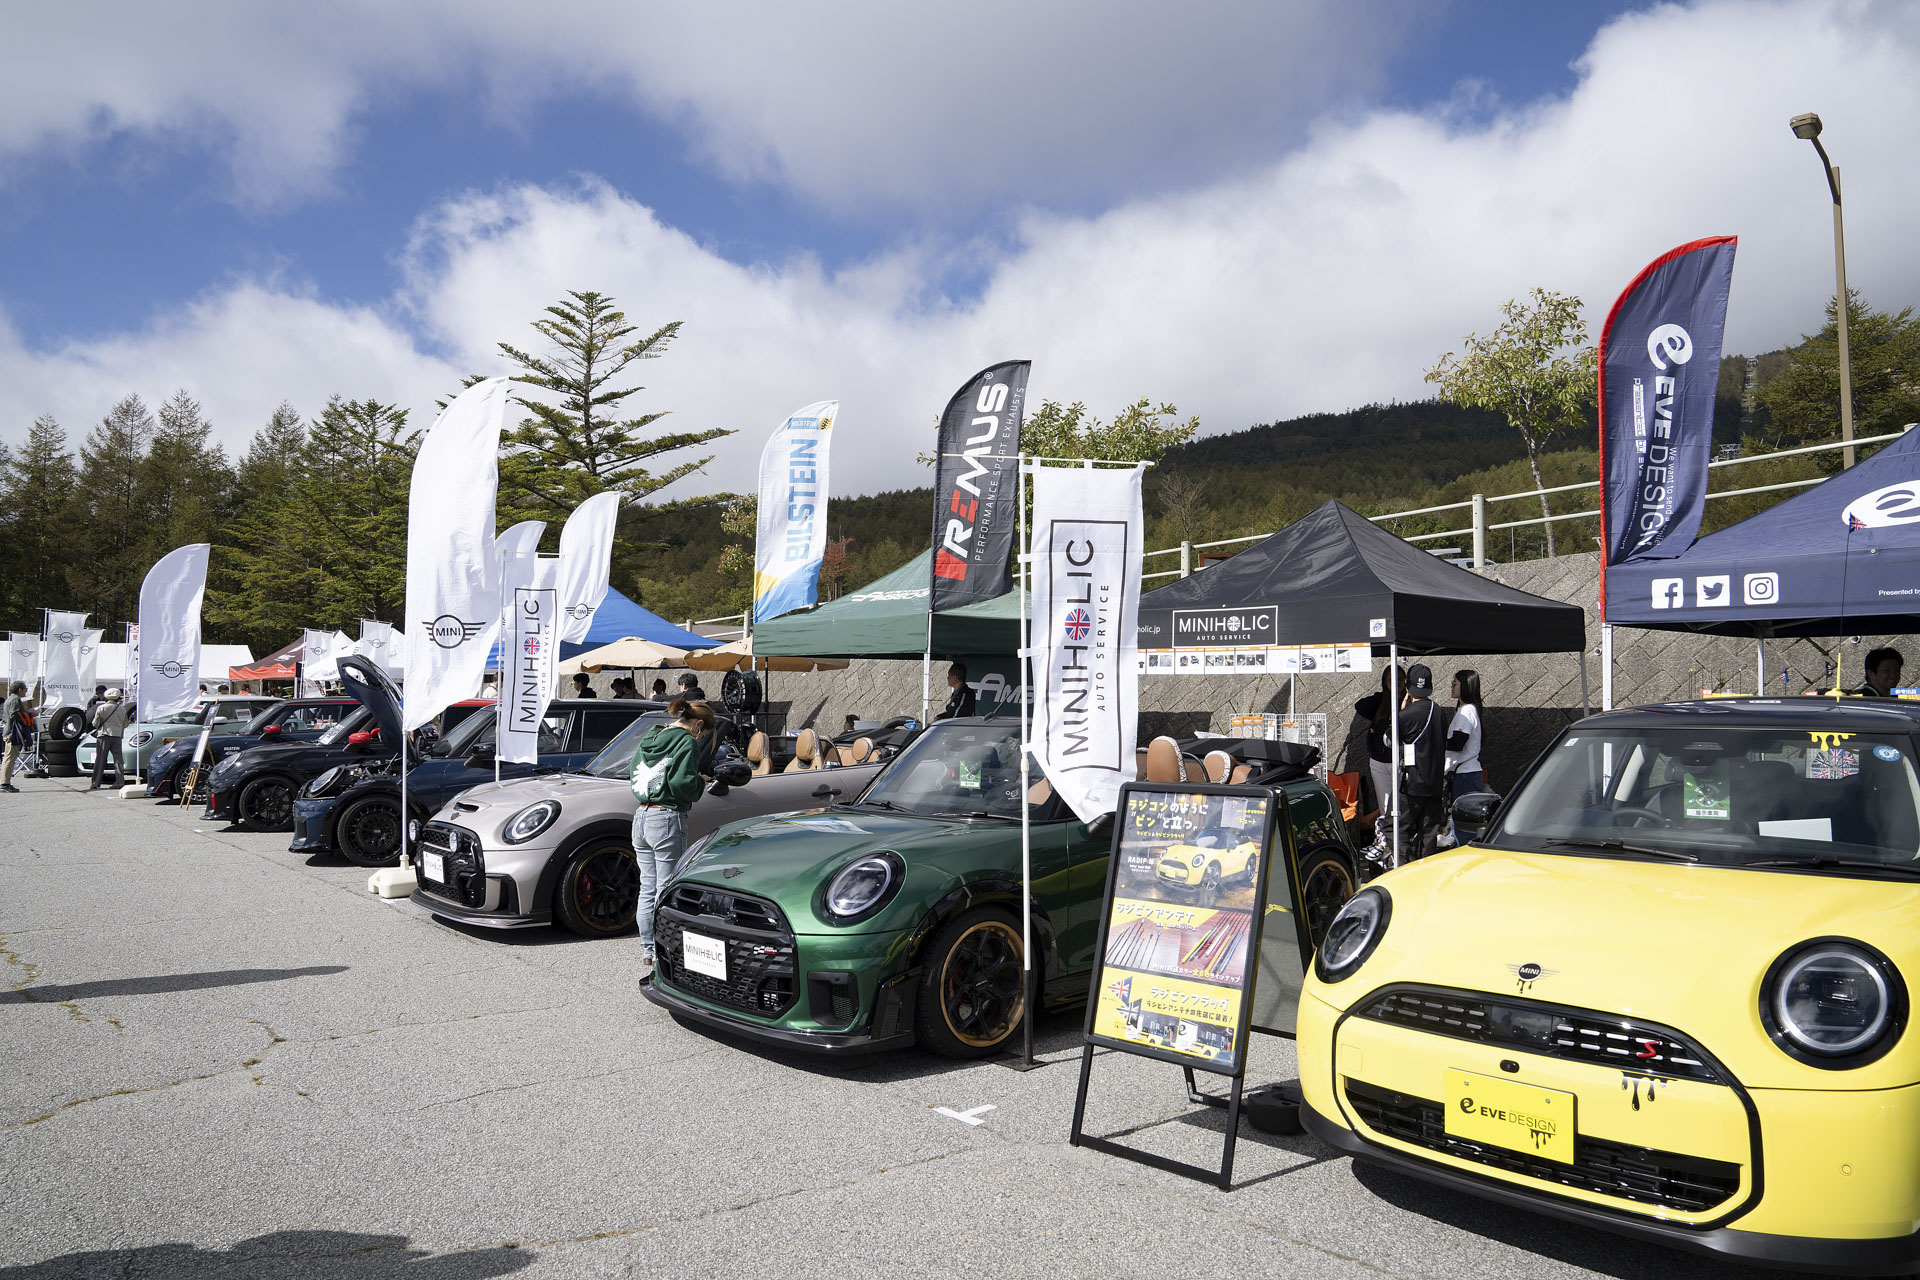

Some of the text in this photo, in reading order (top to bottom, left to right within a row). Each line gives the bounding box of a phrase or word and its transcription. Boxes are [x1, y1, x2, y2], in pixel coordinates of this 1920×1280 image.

[1653, 376, 1675, 439] EVE
[1669, 447, 1677, 461] We
[974, 387, 1024, 561] PERFORMANCE SPORT EXHAUSTS
[1667, 463, 1675, 484] want
[1638, 445, 1668, 546] DESIGN
[1667, 485, 1673, 494] to
[785, 439, 818, 562] BILSTEIN
[1666, 496, 1674, 515] send
[435, 627, 461, 637] MINI
[1097, 585, 1109, 712] AUTO SERVICE
[1128, 799, 1209, 815] ラジコンのように
[1520, 966, 1540, 976] MINI
[1480, 1106, 1506, 1121] EVE
[1508, 1112, 1556, 1133] DESIGN
